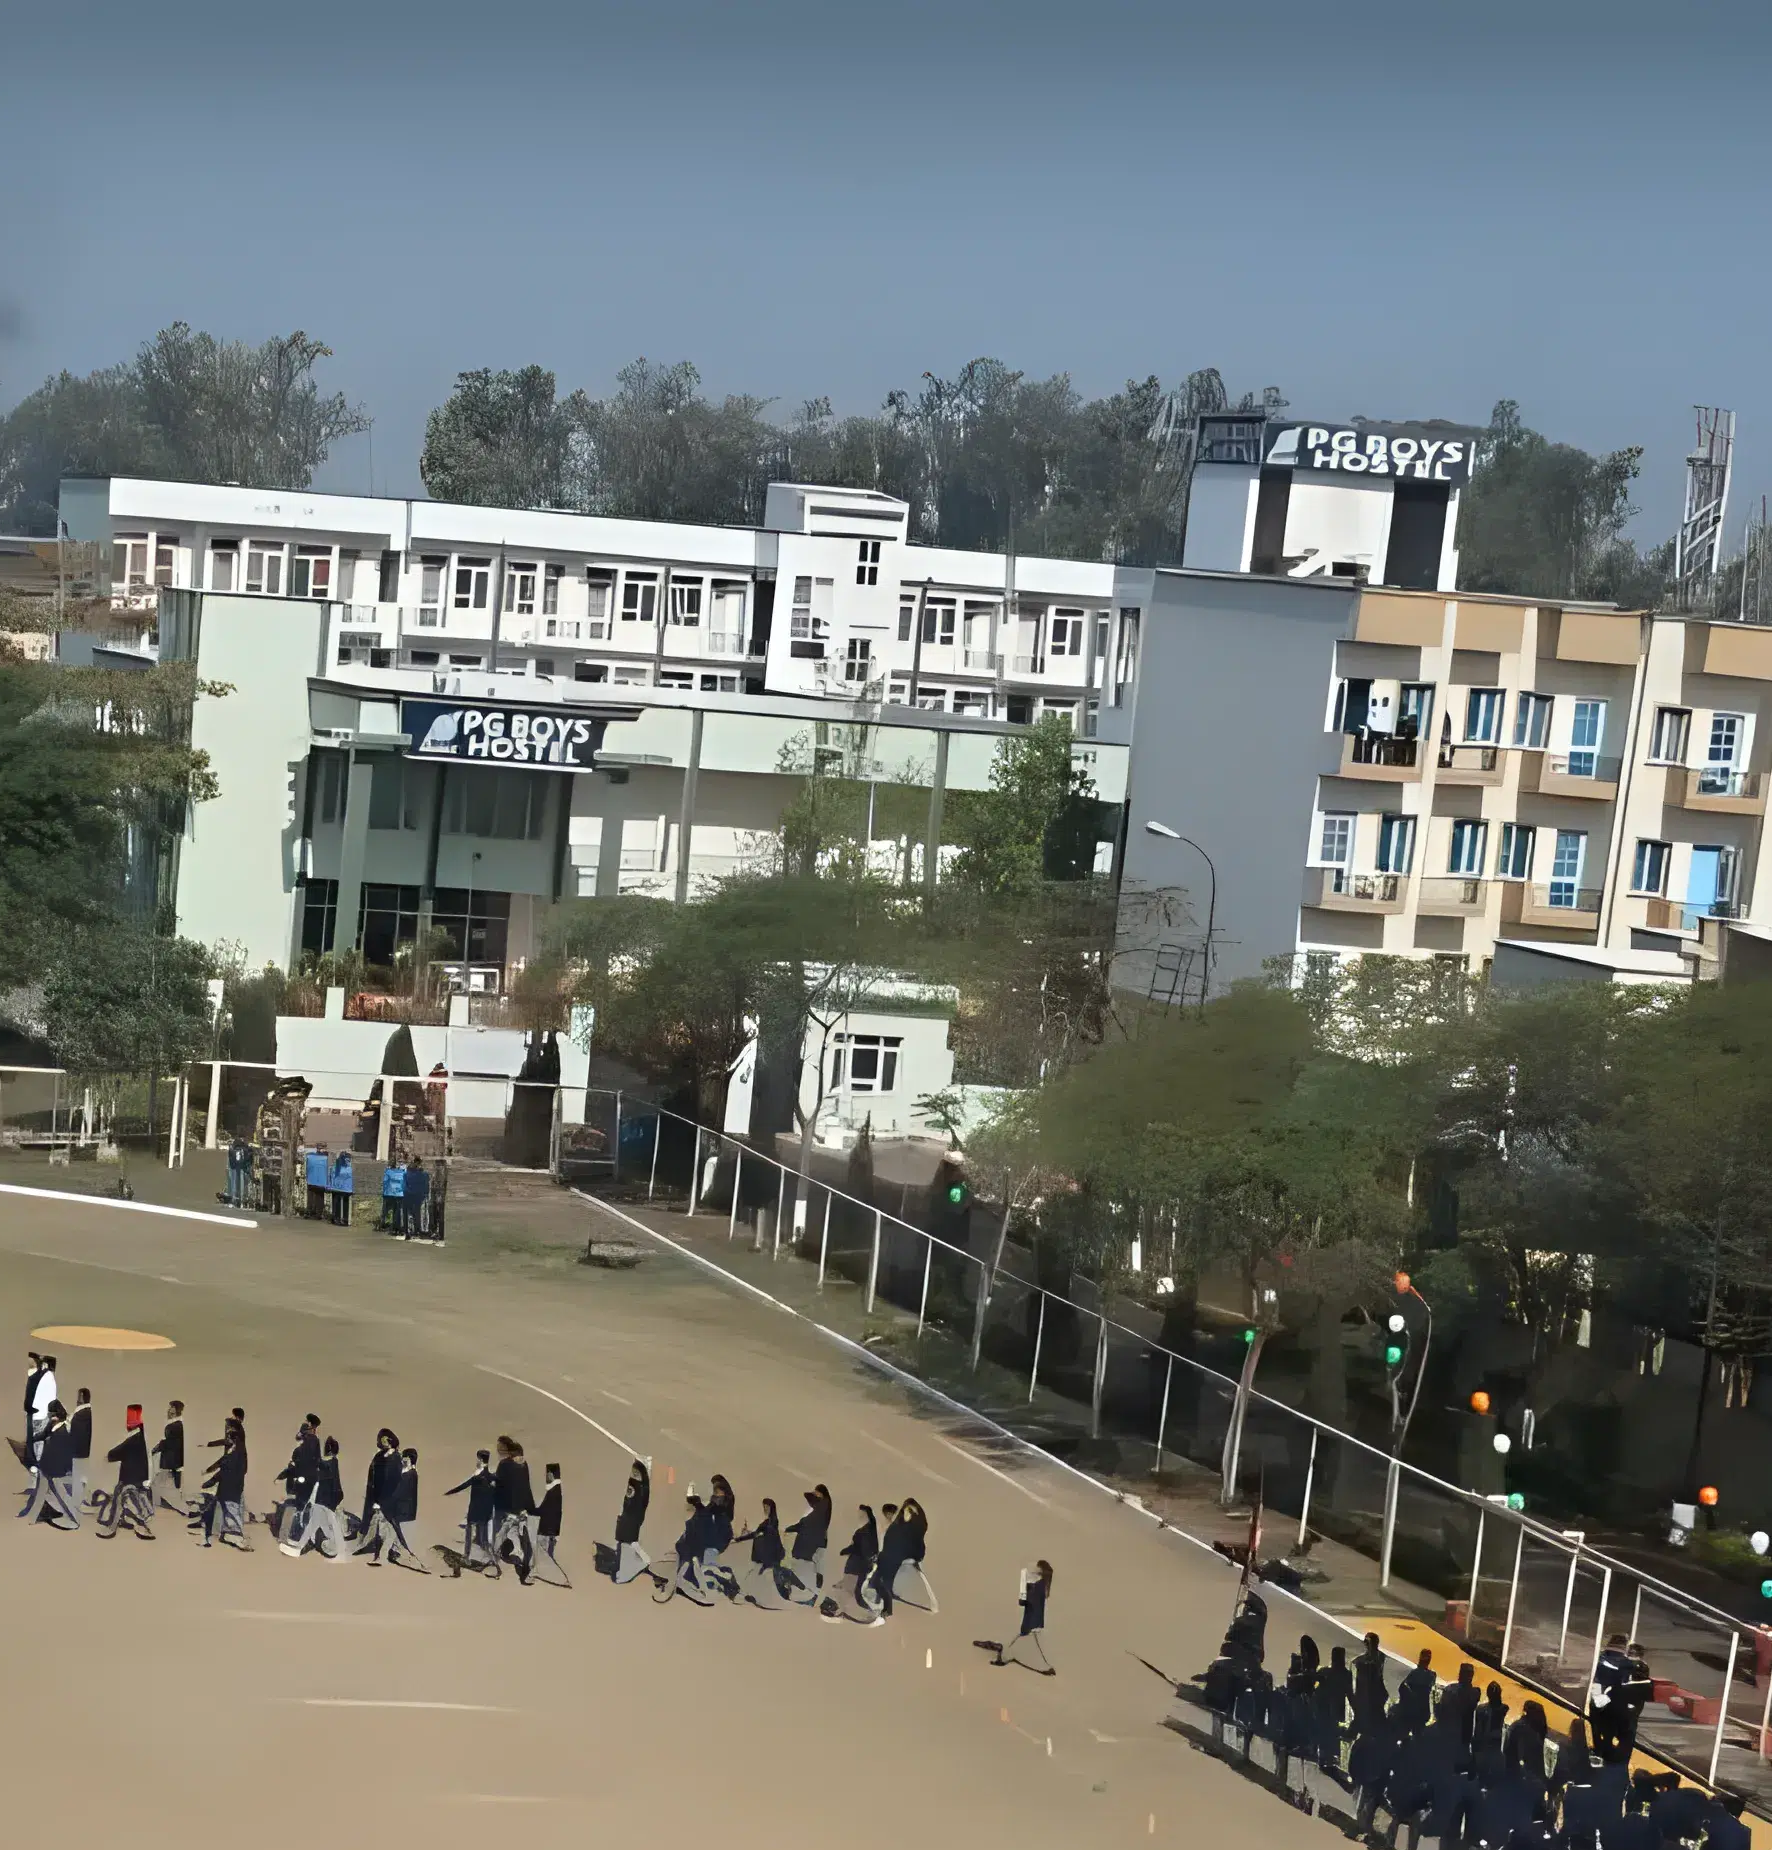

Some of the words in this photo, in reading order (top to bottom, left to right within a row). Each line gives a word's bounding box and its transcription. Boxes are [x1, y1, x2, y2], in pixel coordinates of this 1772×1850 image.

[1307, 427, 1357, 453] PG
[463, 710, 505, 737] PG
[511, 714, 592, 744] BOYS
